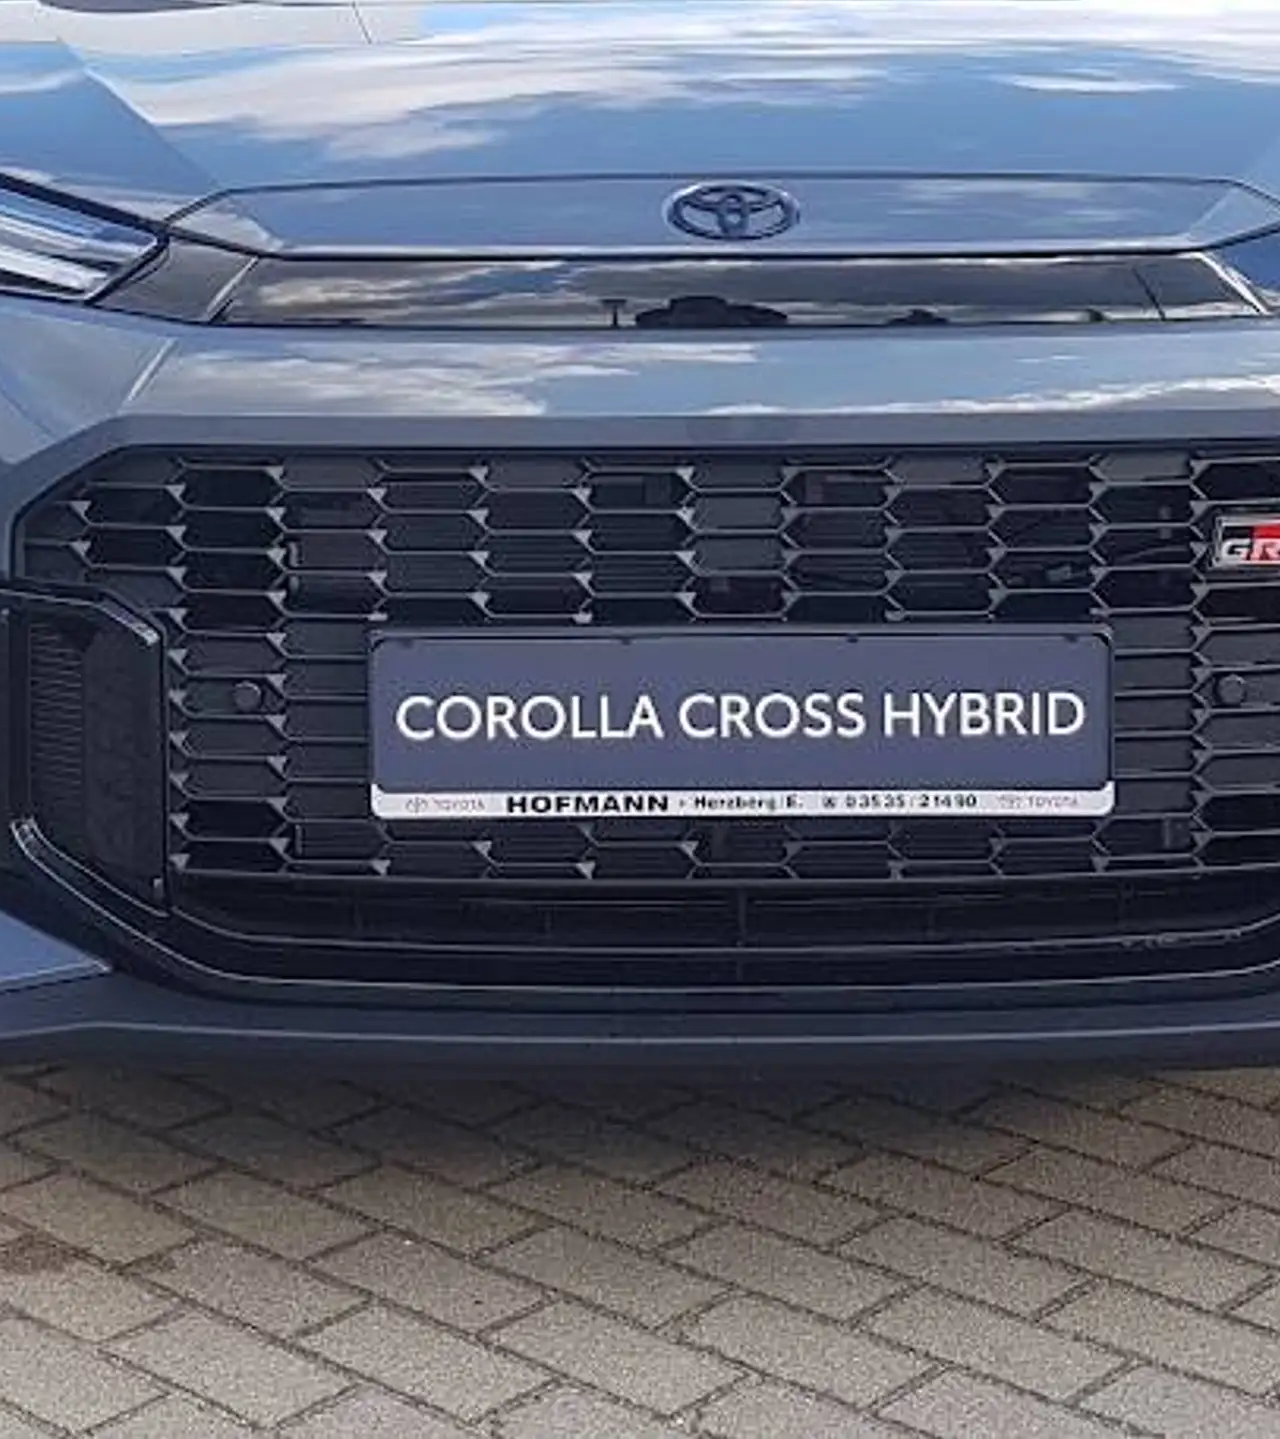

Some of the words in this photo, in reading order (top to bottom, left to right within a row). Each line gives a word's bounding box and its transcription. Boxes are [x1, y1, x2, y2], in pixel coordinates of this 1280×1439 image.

[395, 694, 664, 740] COROLLA
[678, 692, 868, 739] CROSS
[883, 691, 1086, 737] HYBRID
[506, 794, 670, 814] HOFMANN
